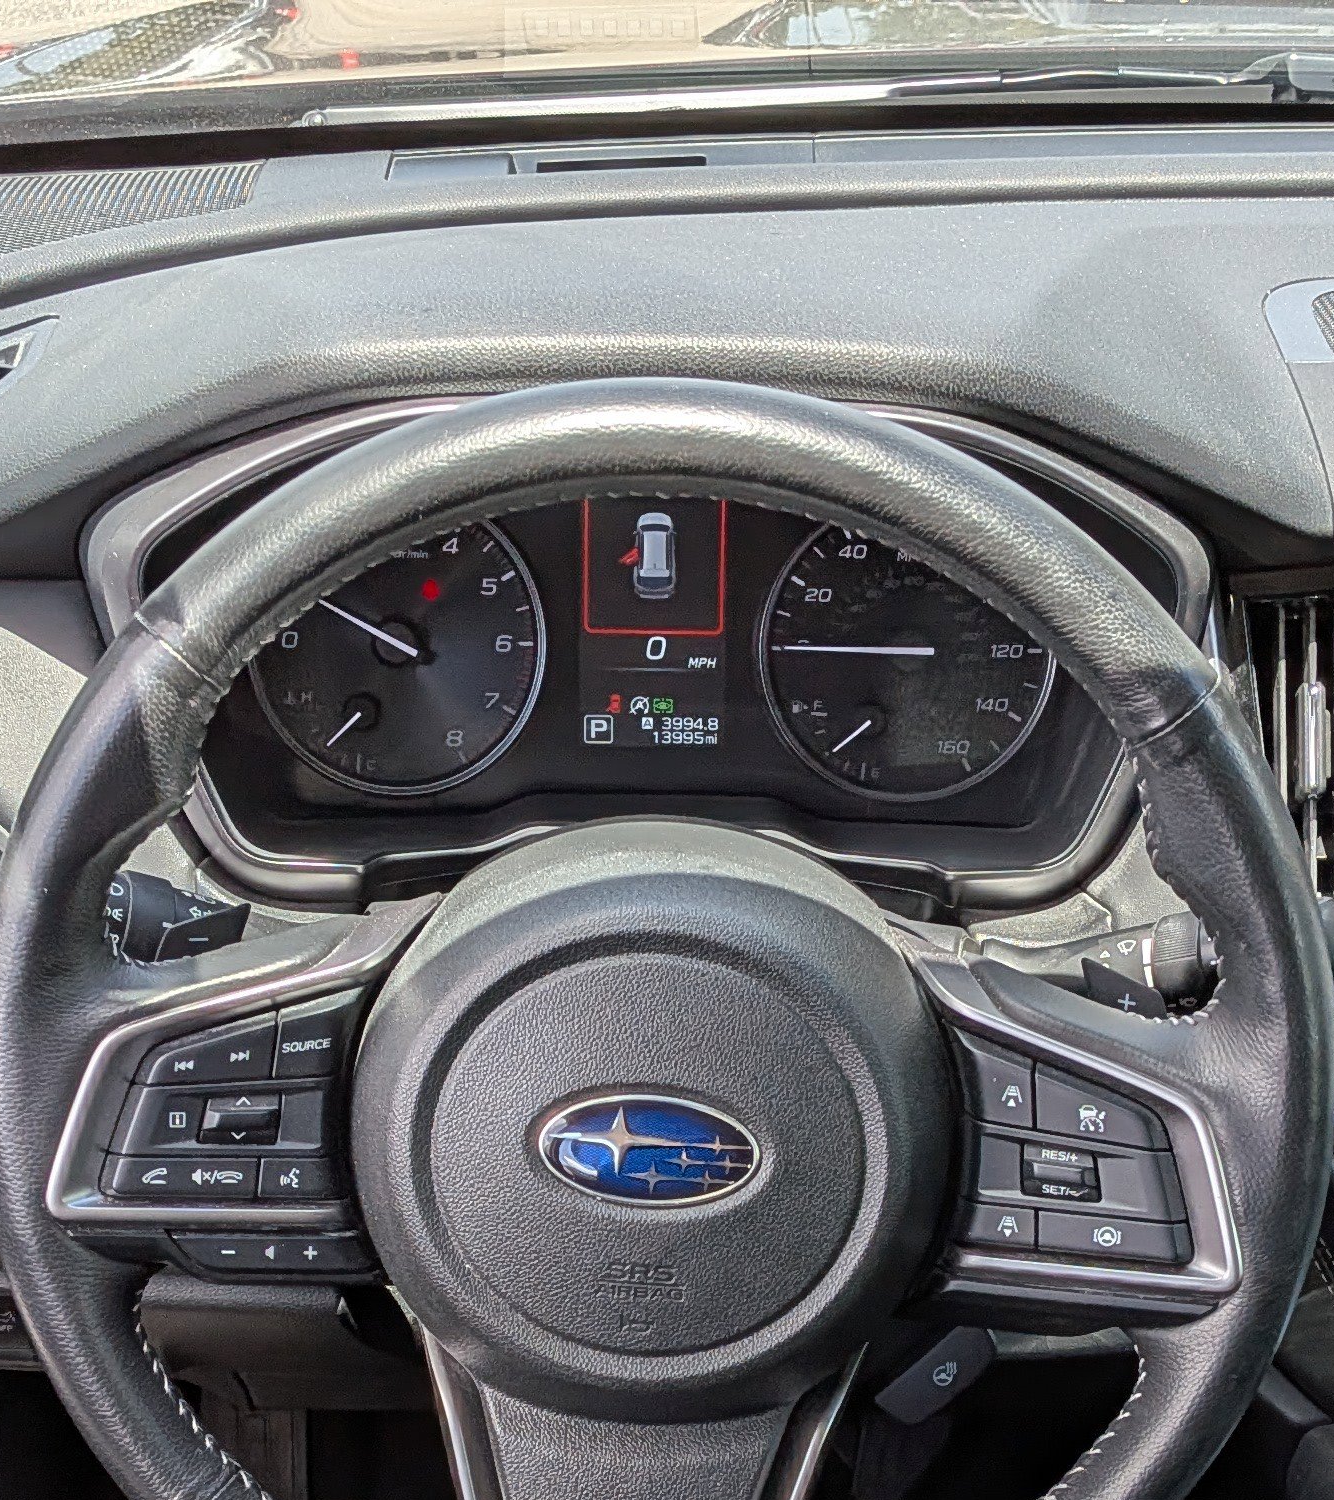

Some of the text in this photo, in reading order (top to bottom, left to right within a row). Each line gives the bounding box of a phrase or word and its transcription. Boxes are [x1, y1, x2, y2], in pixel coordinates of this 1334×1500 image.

[442, 537, 459, 554] 4
[838, 544, 868, 559] 40
[480, 578, 498, 596] 5
[804, 588, 832, 602] 20
[281, 630, 299, 649] 0
[494, 634, 513, 653] 6
[645, 635, 667, 660] 0
[990, 644, 1024, 659] 120
[687, 656, 717, 669] MPH
[484, 692, 500, 709] 7
[975, 698, 1009, 713] 140
[590, 719, 608, 739] P
[661, 716, 719, 730] 3994.8
[445, 729, 463, 747] 8
[937, 739, 970, 754] 160
[281, 1038, 331, 1053] SOURCE
